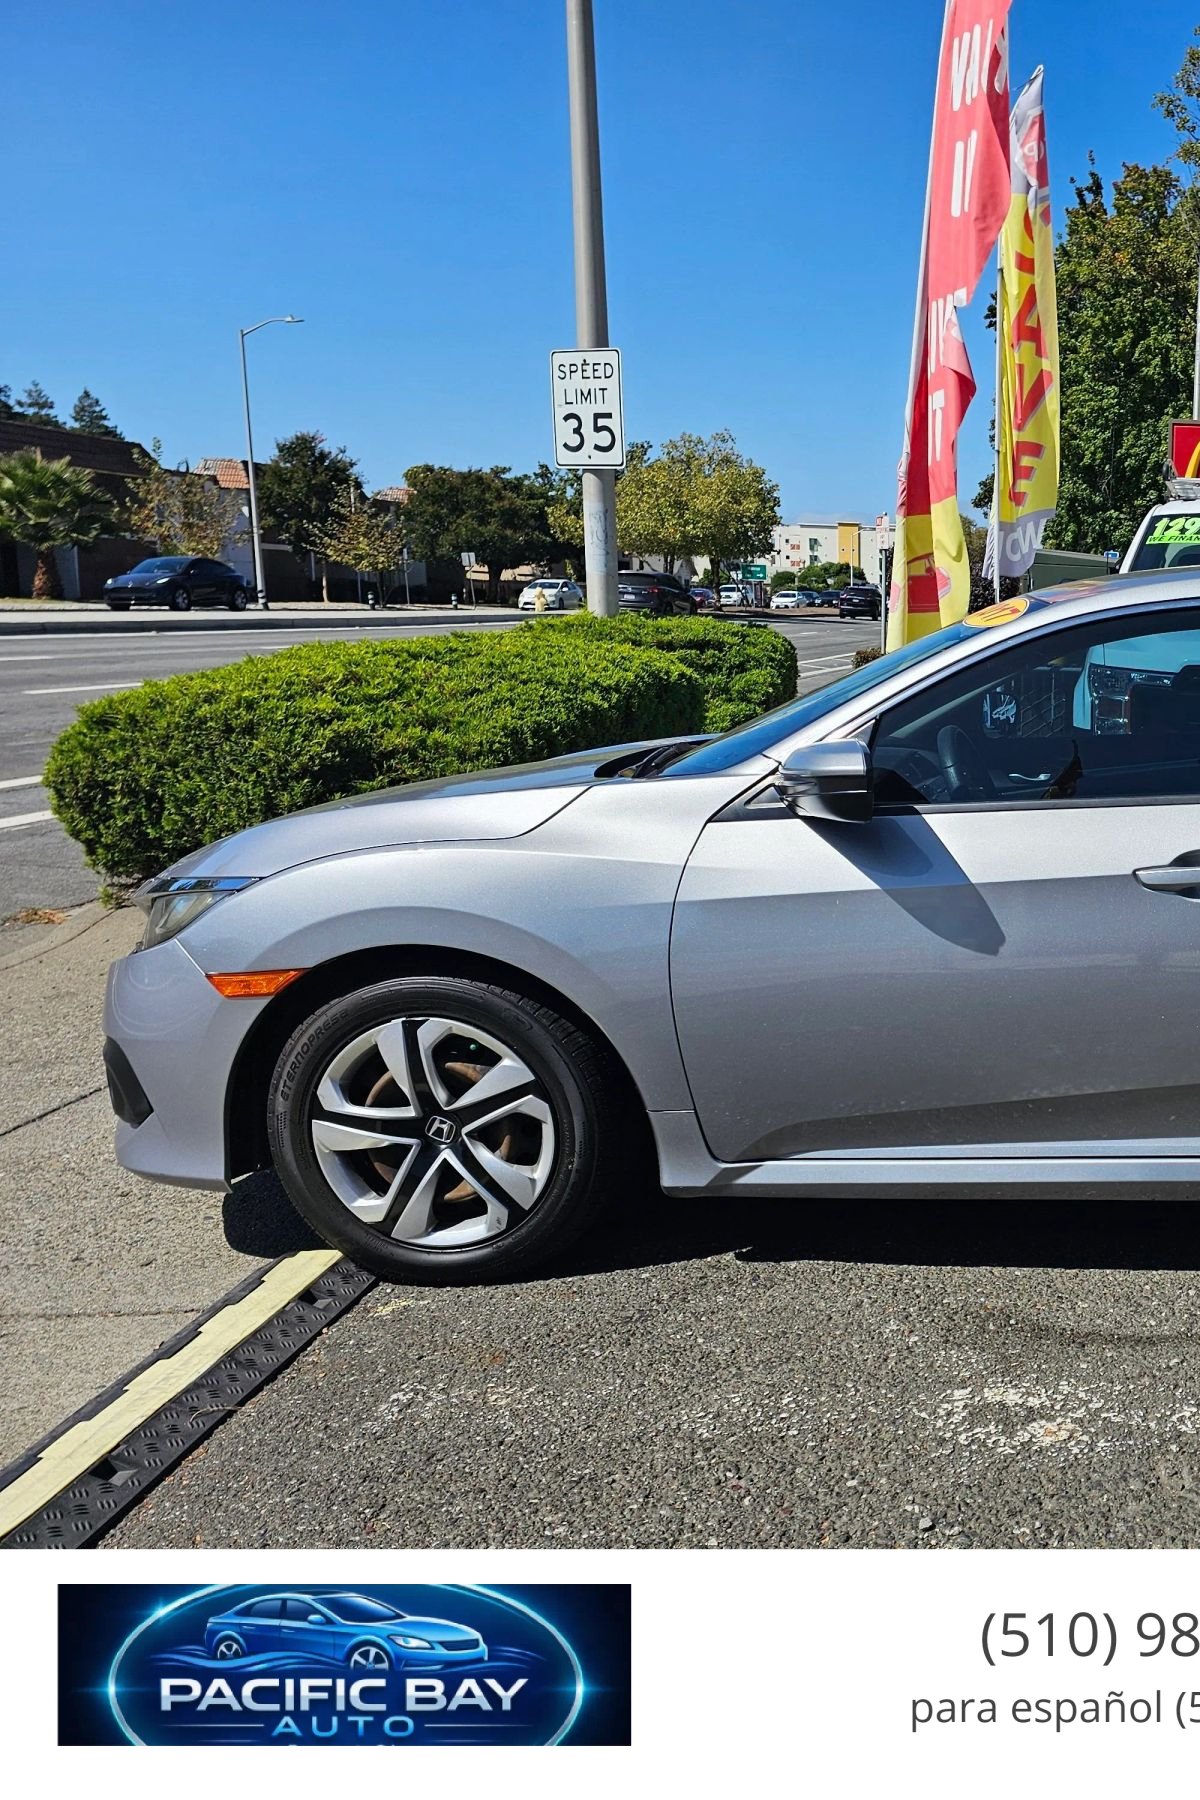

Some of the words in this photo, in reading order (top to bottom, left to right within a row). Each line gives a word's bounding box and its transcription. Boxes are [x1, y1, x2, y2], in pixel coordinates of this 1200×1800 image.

[557, 362, 614, 380] SPEED
[564, 387, 608, 405] LIMIT
[562, 412, 616, 453] 35
[1148, 535, 1166, 543] WE
